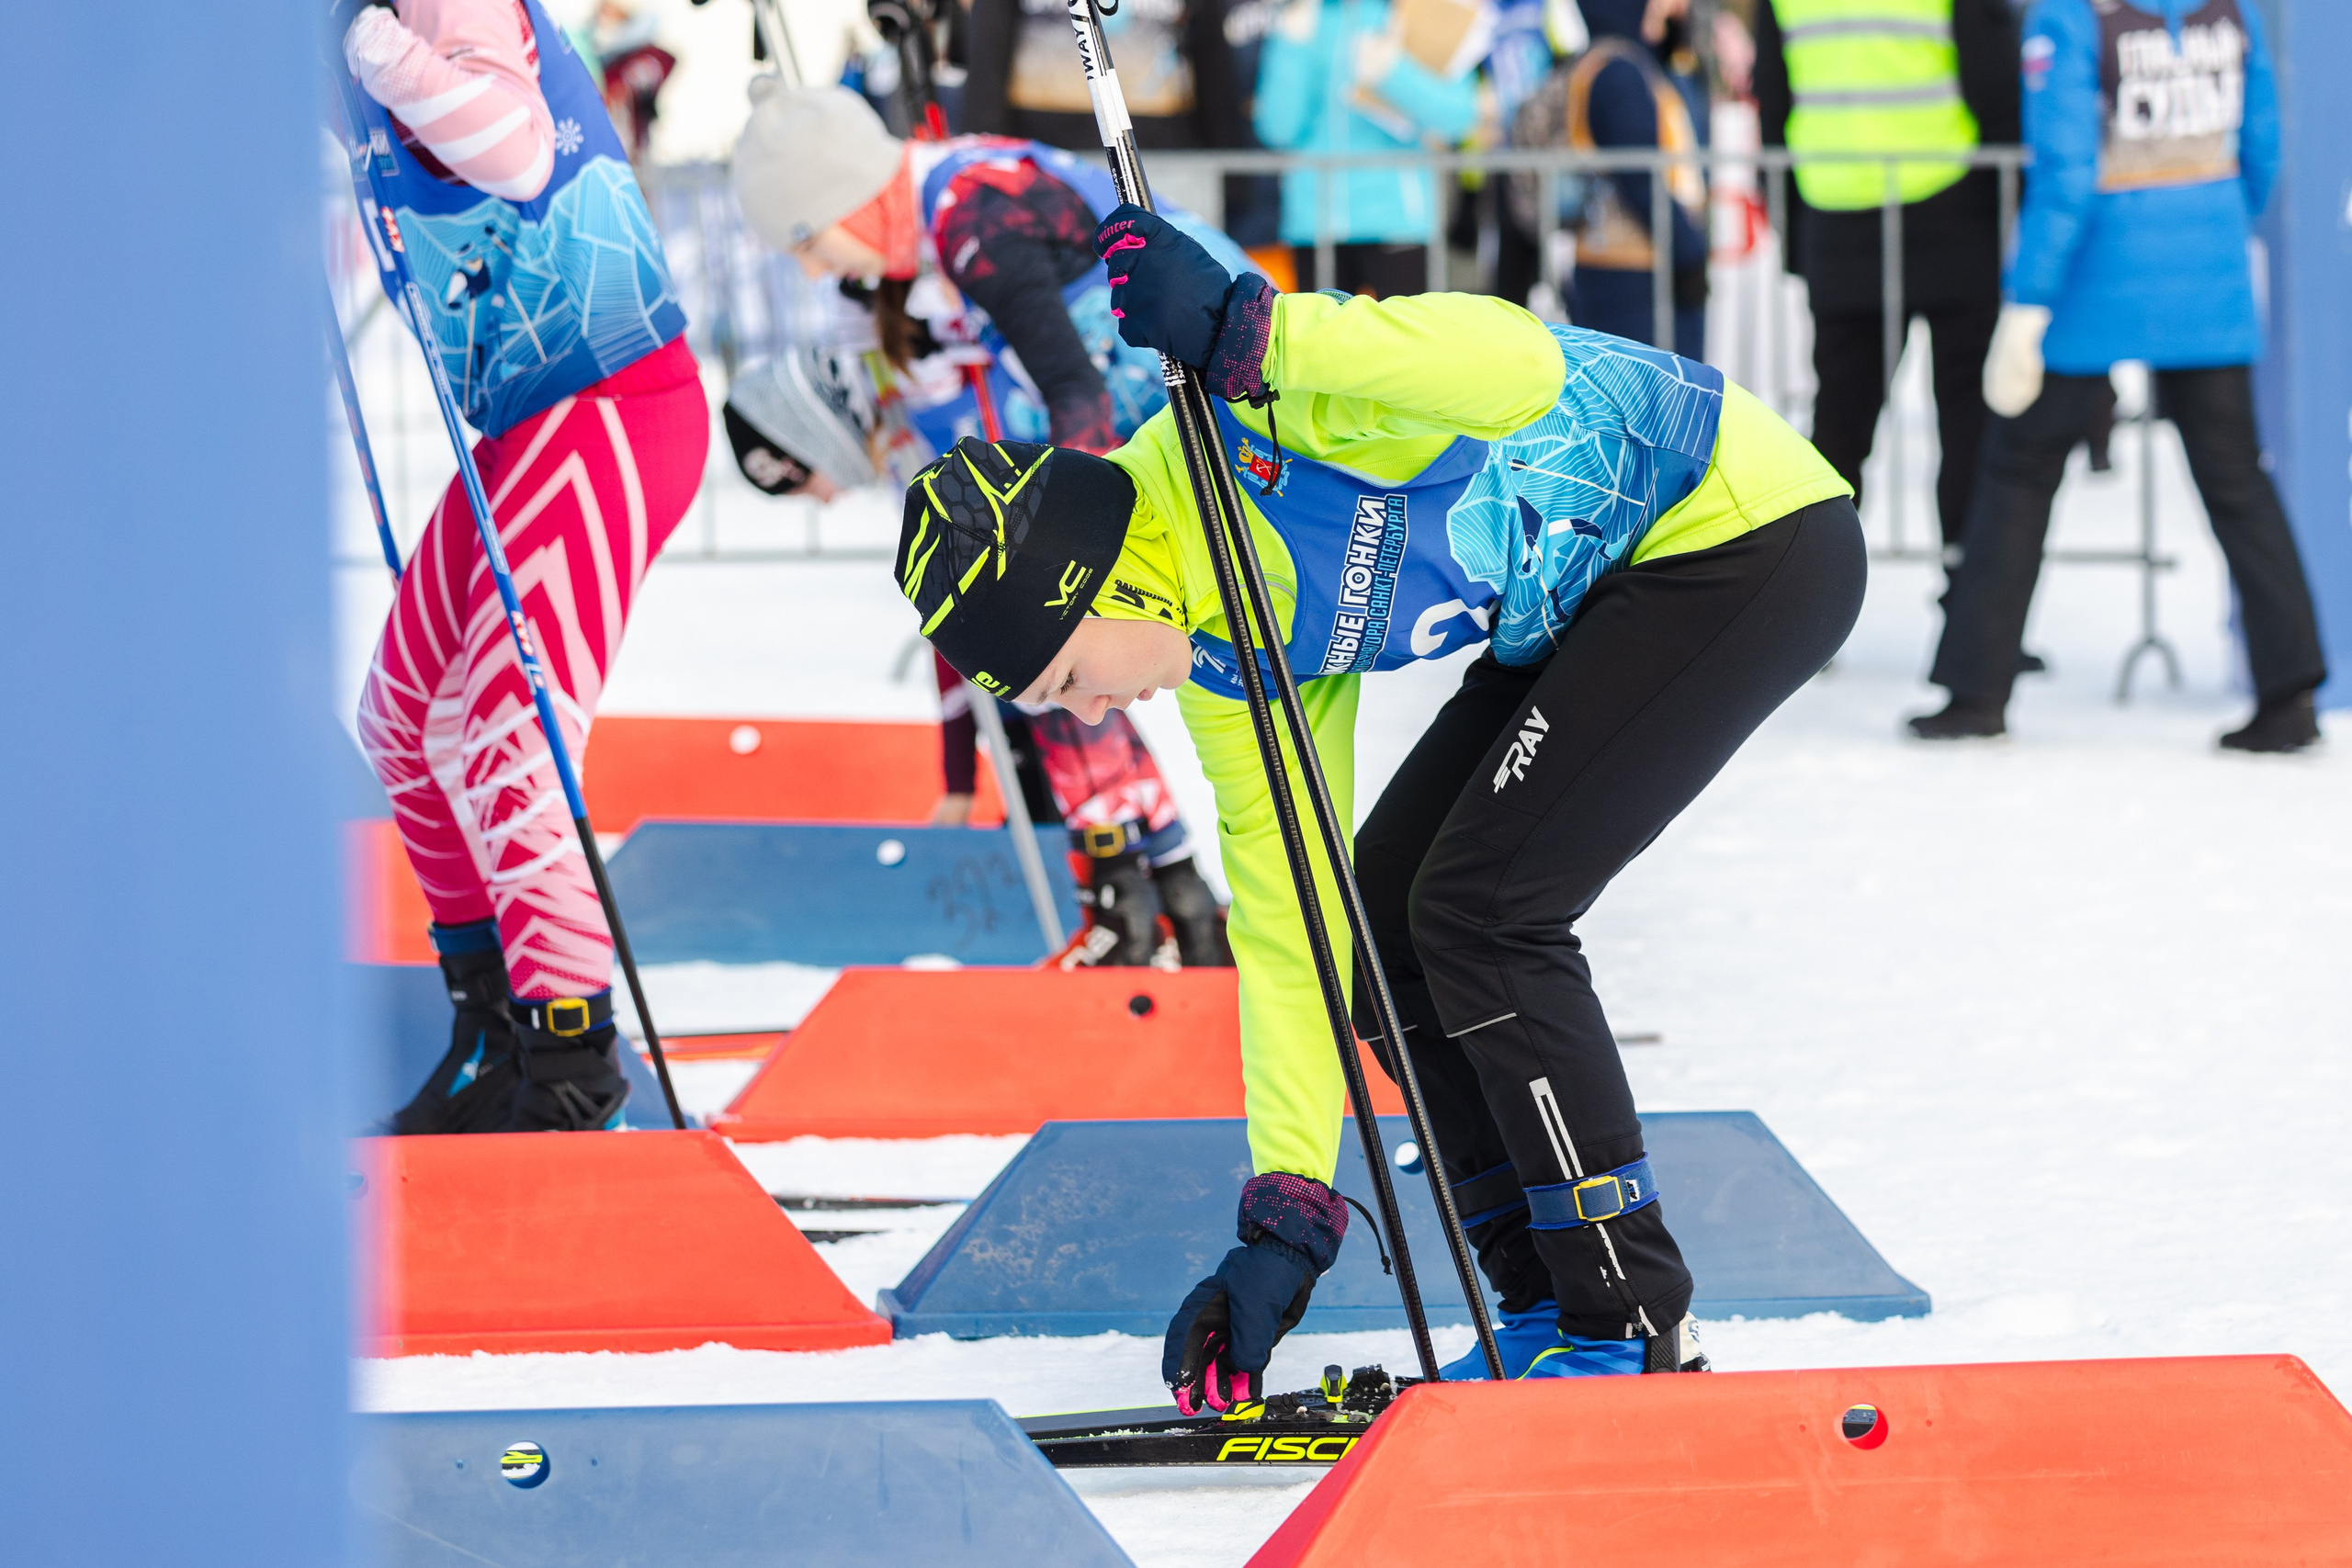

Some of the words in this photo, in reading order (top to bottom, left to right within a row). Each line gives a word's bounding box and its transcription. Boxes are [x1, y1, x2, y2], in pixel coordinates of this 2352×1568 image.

[1097, 219, 1136, 244] winter
[1342, 500, 1386, 605] ГОНКИ
[1370, 497, 1405, 617] САНКТ-ПЕТЕРБУРГА
[1058, 592, 1080, 621] VICTORY
[1079, 568, 1094, 590] CODE
